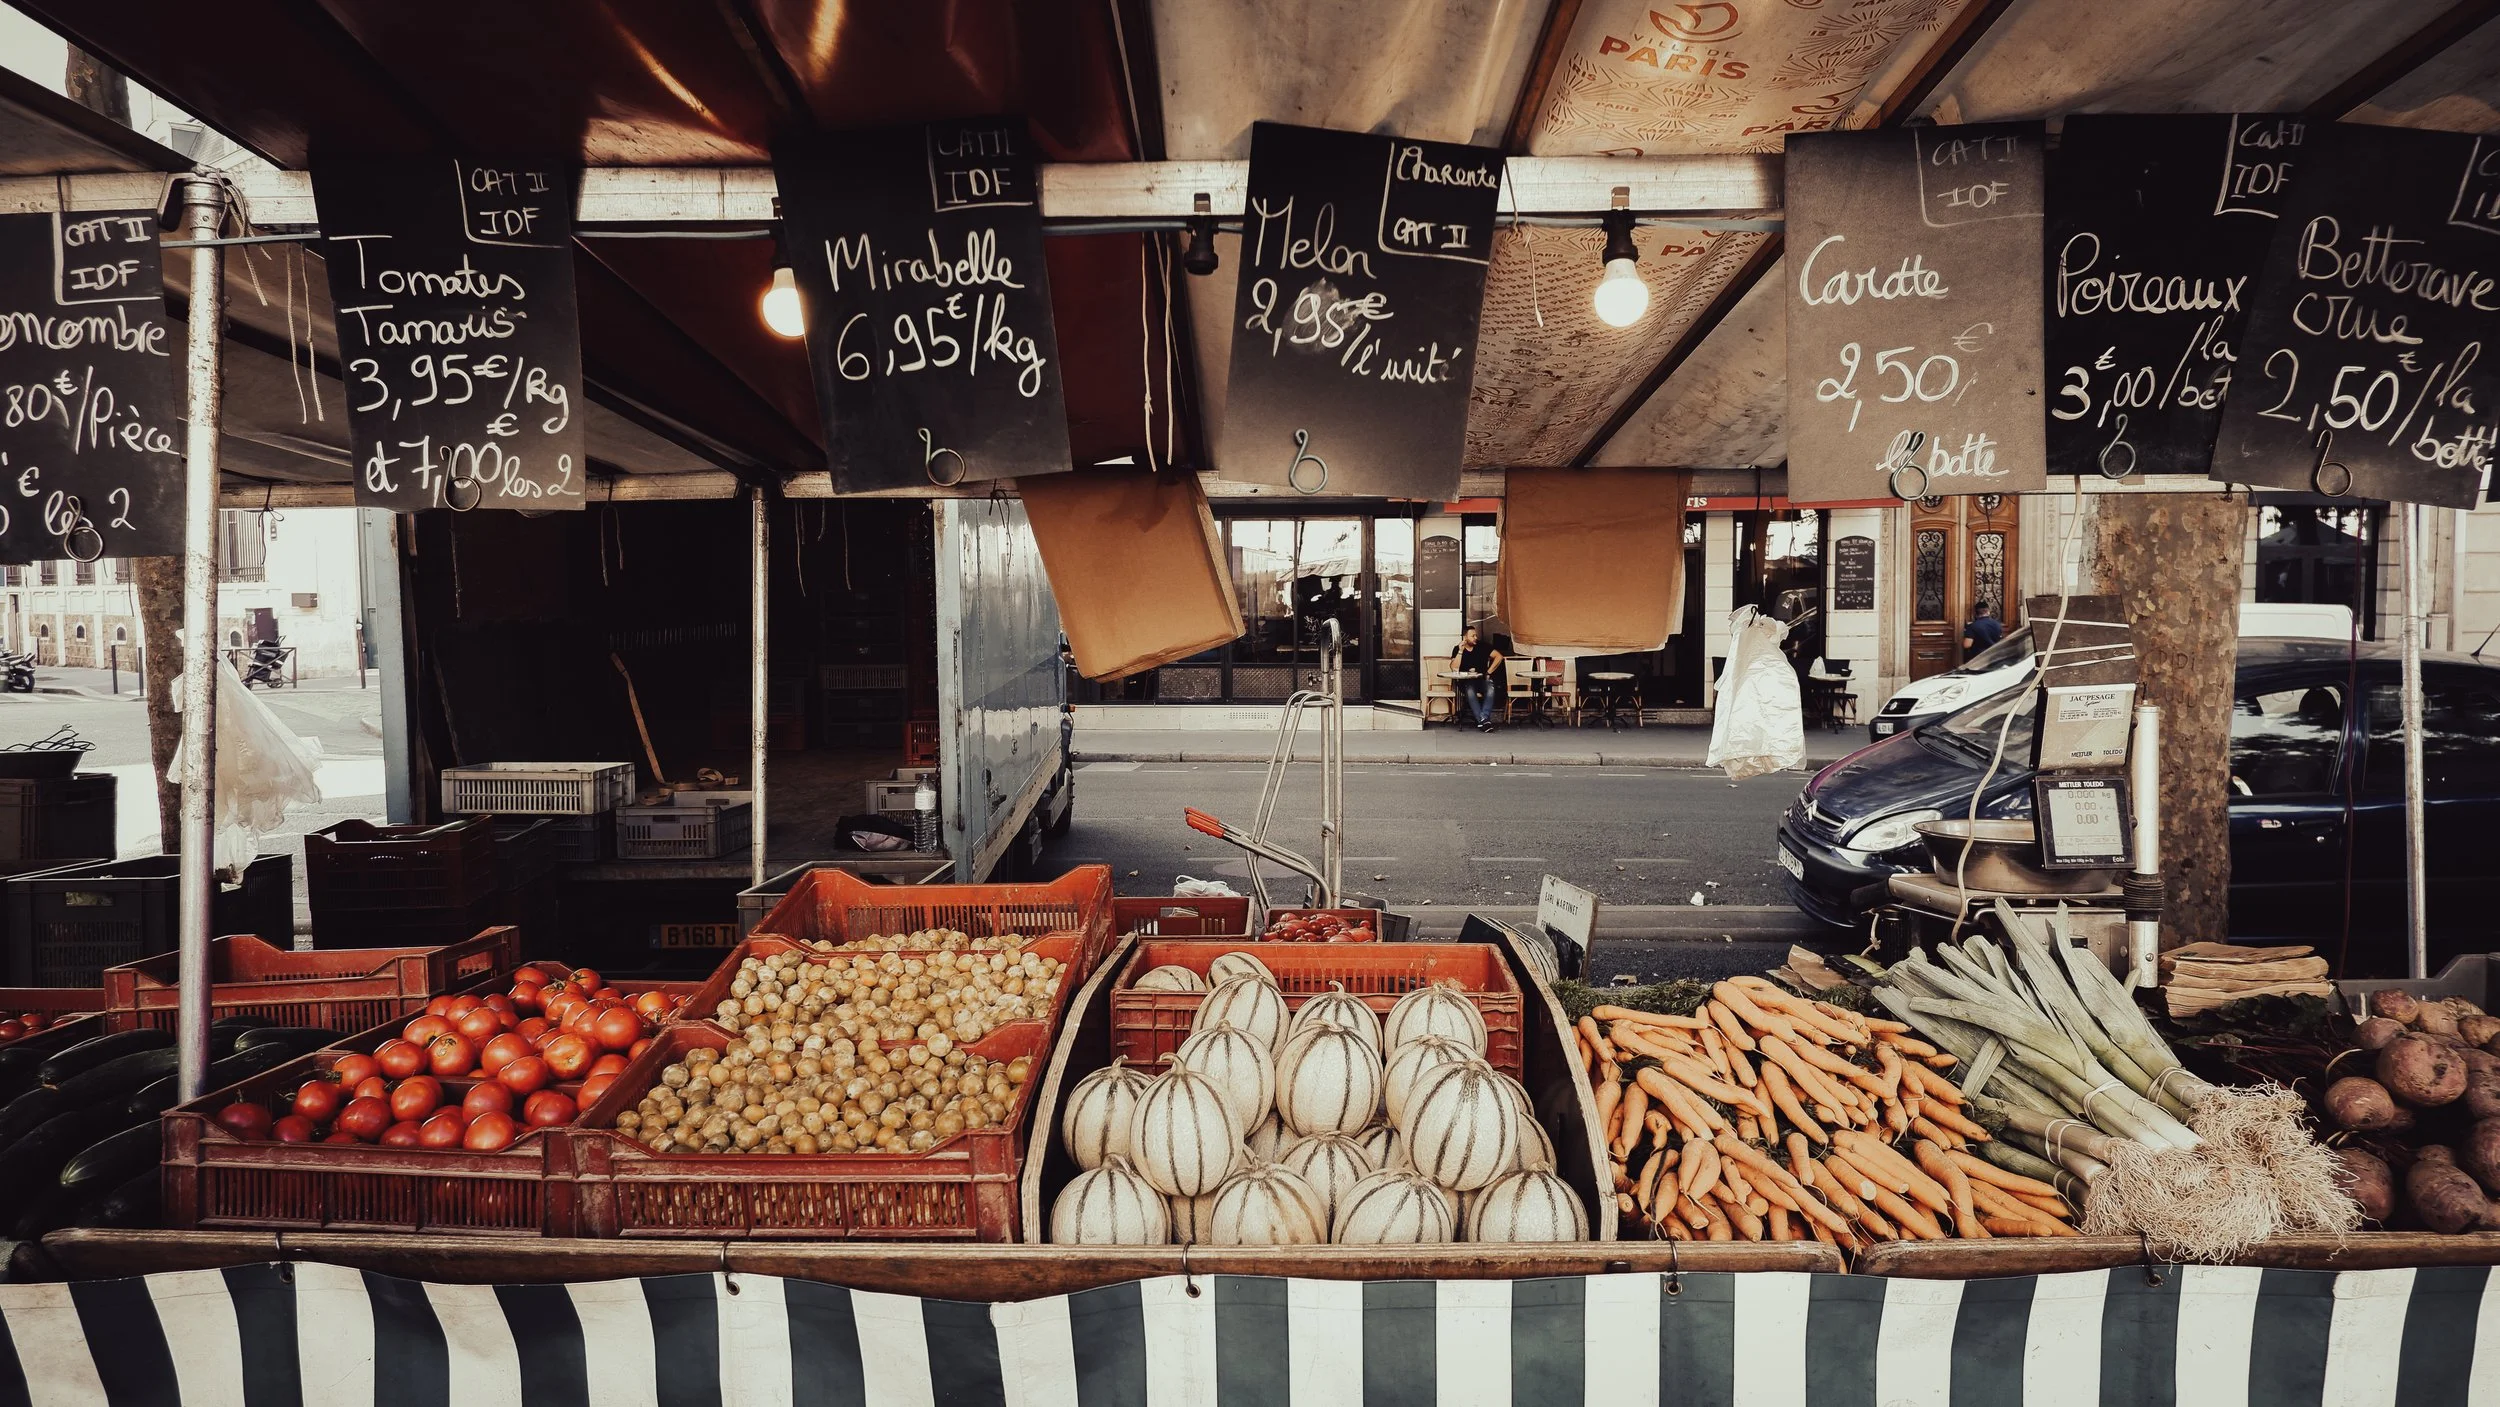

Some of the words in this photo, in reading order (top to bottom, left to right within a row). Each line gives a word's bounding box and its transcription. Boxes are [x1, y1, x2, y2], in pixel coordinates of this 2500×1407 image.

[1599, 35, 1750, 79] PARIS
[1634, 34, 1695, 53] VILLE
[1707, 50, 1735, 58] DE
[1663, 88, 1713, 99] PARIS
[1742, 120, 1832, 136] PAR
[472, 167, 517, 196] CAT
[944, 168, 1011, 203] IDF
[2231, 162, 2295, 198] IDF
[65, 216, 120, 246] CAT
[480, 207, 540, 236] IDF
[1252, 196, 1377, 279] Melon
[329, 235, 525, 300] Tomates
[825, 228, 1025, 292] Mirabelle
[1661, 244, 1706, 257] PA
[1800, 235, 1949, 306] Carotte
[2298, 215, 2500, 311] Betterave
[70, 260, 140, 290] IDF
[2057, 233, 2247, 318] Poireaux
[0, 304, 170, 356] oncombre
[341, 305, 518, 346] Tamaris
[500, 455, 542, 498] les
[548, 454, 580, 496] 2
[1929, 433, 2010, 478] botte
[109, 487, 136, 530] 2
[1686, 496, 1707, 508] ris
